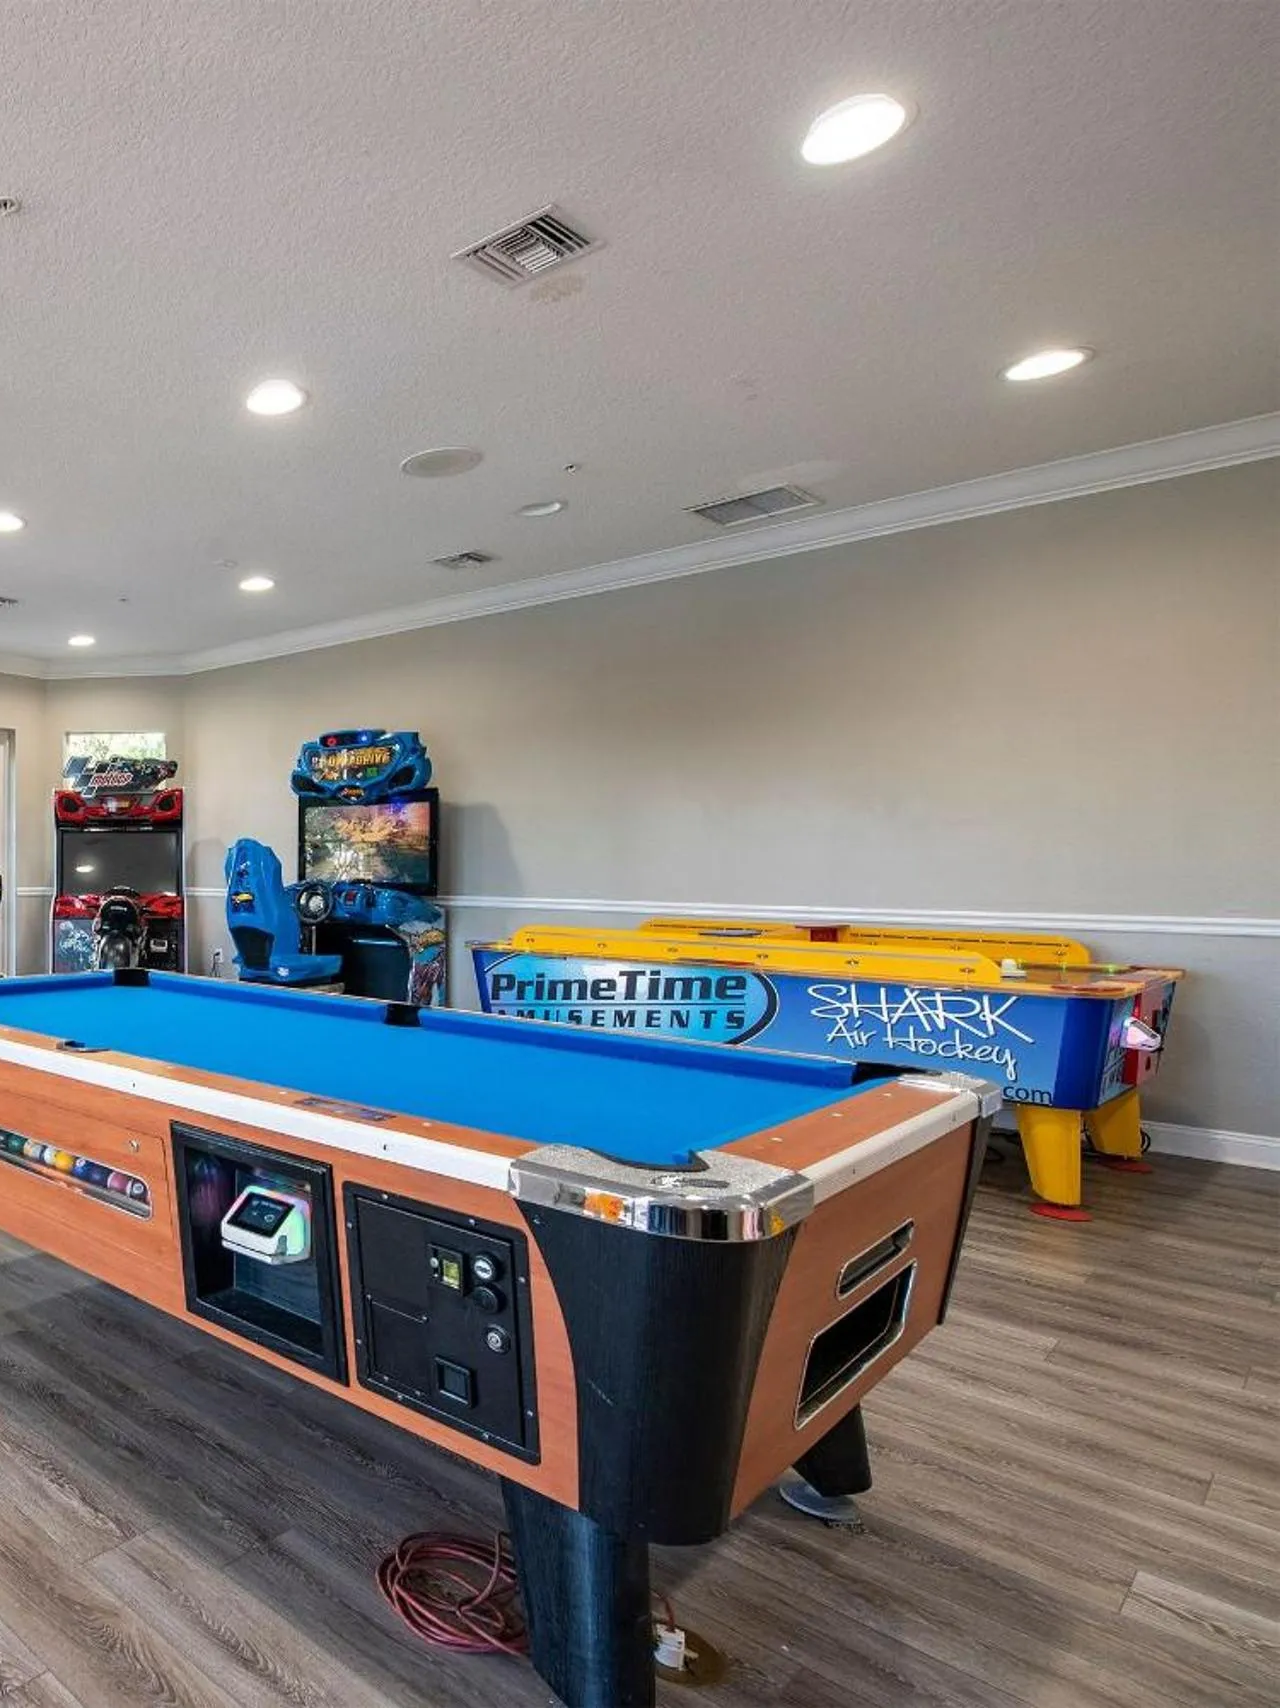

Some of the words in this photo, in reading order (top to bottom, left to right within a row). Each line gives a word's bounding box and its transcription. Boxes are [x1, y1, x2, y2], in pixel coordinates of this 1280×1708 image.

[491, 970, 747, 1001] PrimeTime
[807, 983, 1034, 1043] SHARK
[827, 1017, 876, 1048] Air
[883, 1023, 1018, 1081] Hockey
